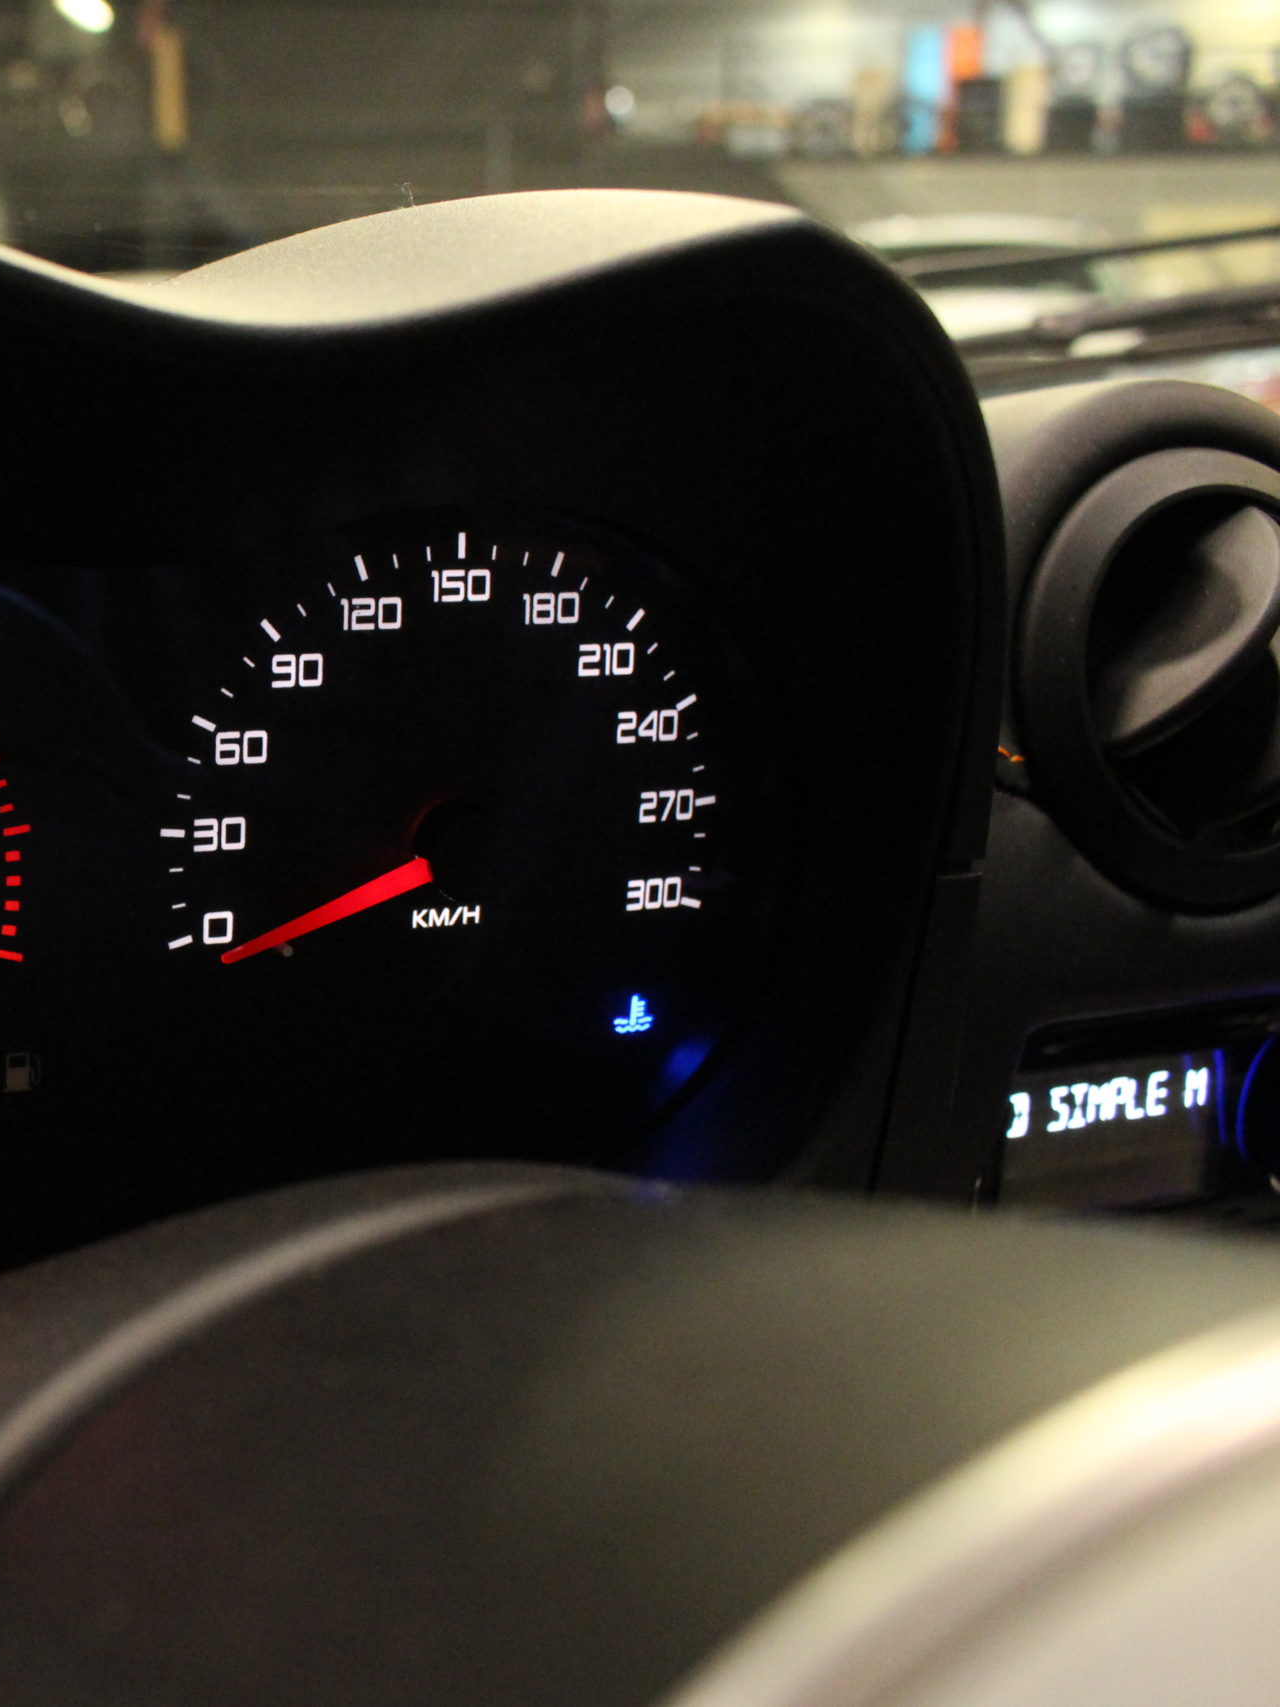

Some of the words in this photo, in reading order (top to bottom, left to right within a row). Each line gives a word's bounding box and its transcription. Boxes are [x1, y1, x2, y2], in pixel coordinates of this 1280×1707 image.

[432, 569, 490, 602] 150
[341, 597, 402, 630] 120
[523, 592, 579, 625] 180
[272, 653, 323, 688] 90
[578, 643, 634, 677] 210
[617, 710, 678, 744] 240
[215, 730, 268, 765] 60
[639, 789, 693, 823] 270
[194, 817, 246, 852] 30
[626, 877, 682, 911] 300
[203, 911, 233, 944] 0
[412, 905, 480, 928] KM/H
[1047, 1070, 1169, 1133] SIMPLE
[1182, 1067, 1209, 1108] M
